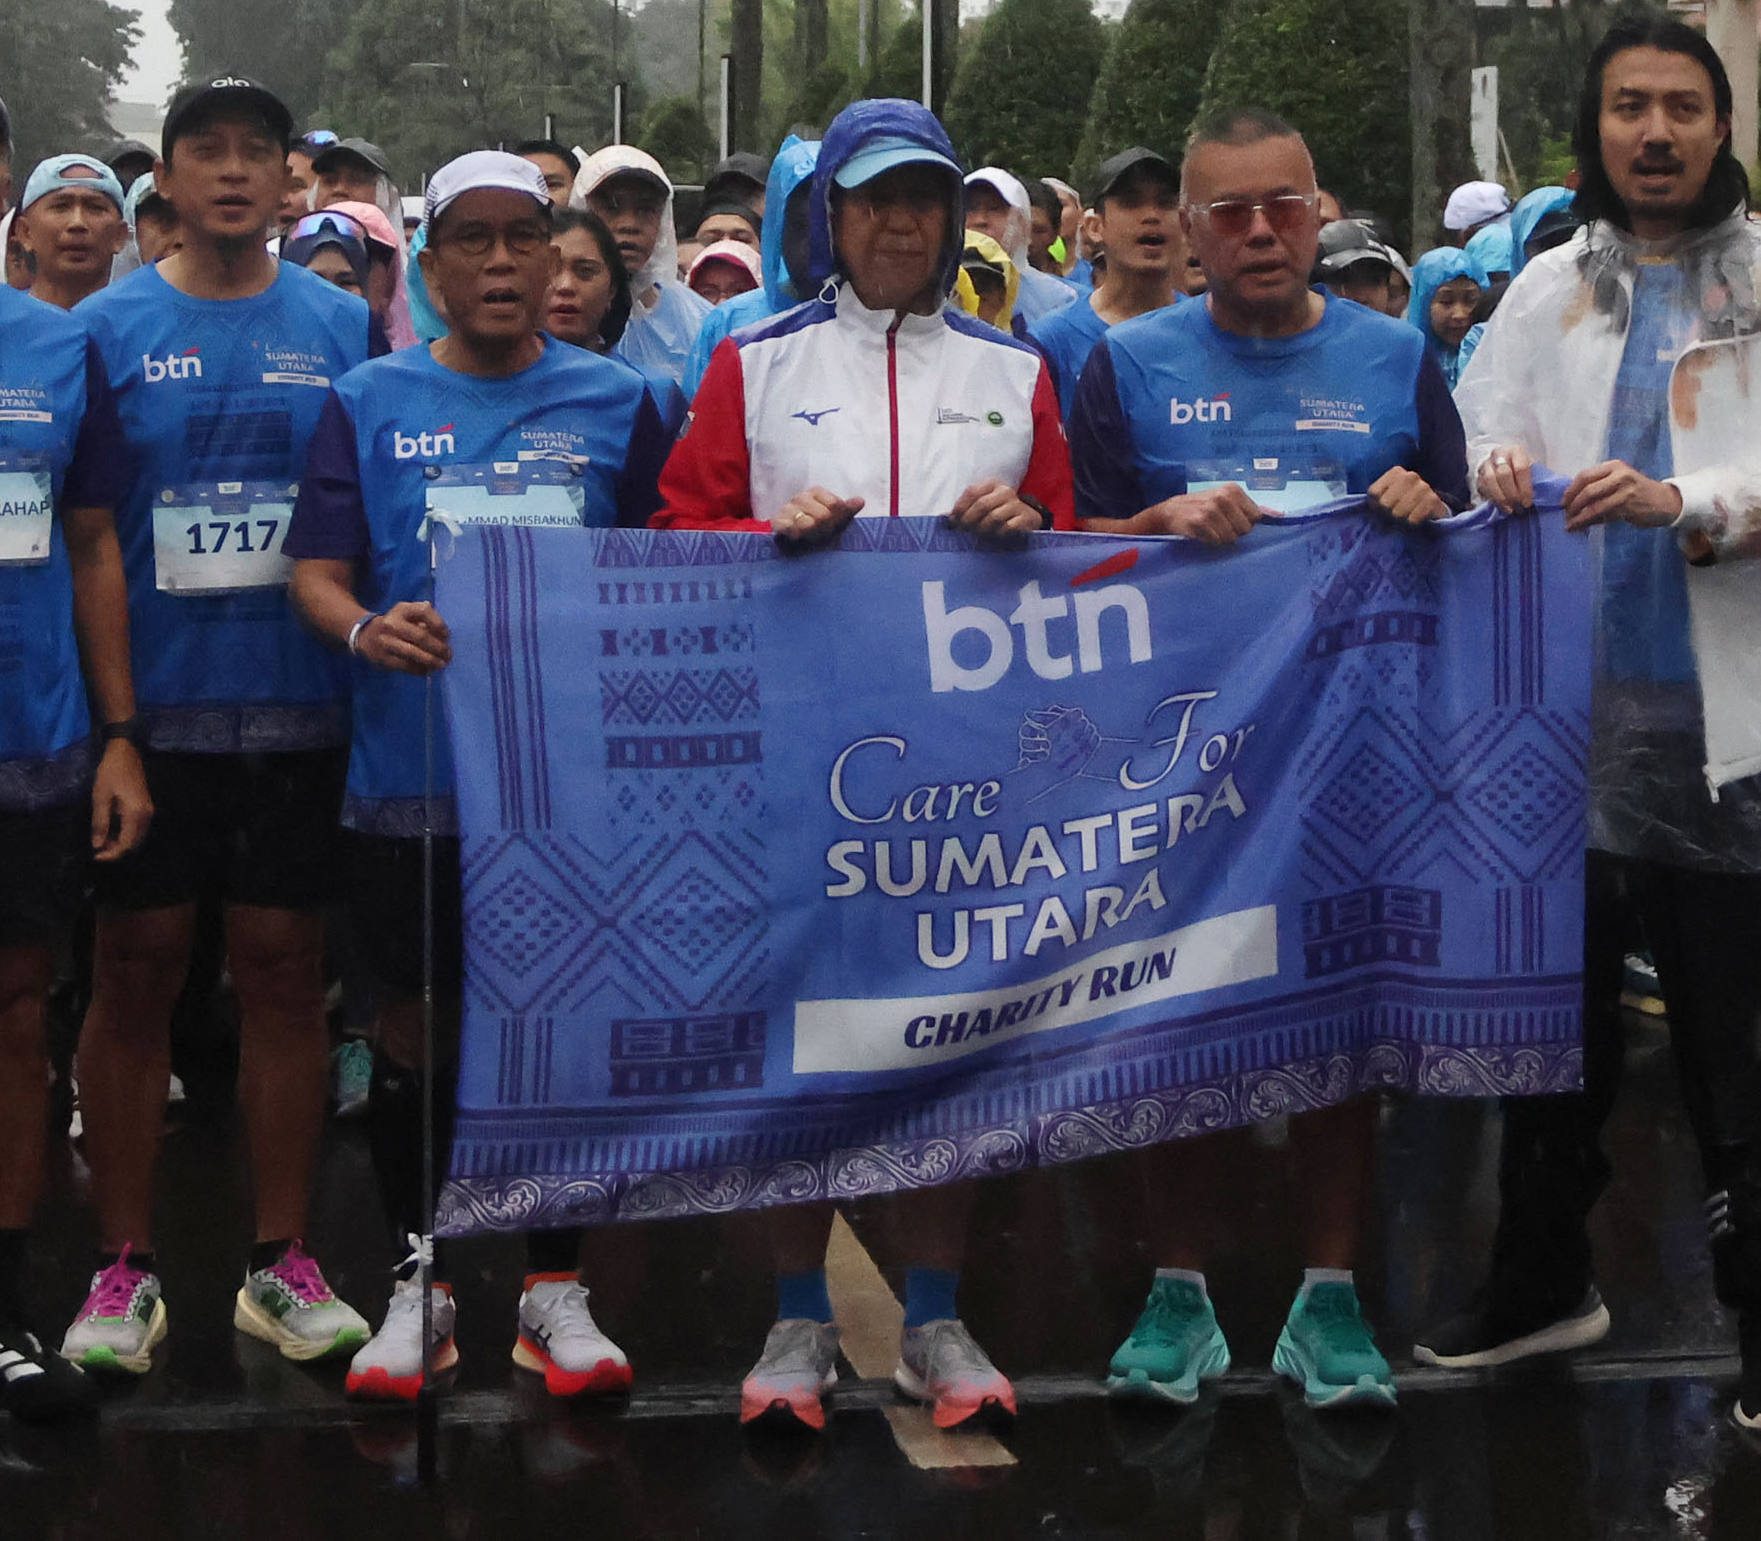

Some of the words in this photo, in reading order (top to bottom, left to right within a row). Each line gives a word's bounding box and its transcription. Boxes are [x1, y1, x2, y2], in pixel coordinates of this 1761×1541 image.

[143, 348, 202, 383] btn
[1170, 392, 1231, 424] btn
[1300, 399, 1365, 411] SUMATERA
[394, 423, 455, 459] btn
[186, 520, 278, 554] 1717
[923, 548, 1153, 693] btn
[829, 735, 1001, 824] Care
[1119, 690, 1255, 790] For
[826, 772, 1246, 898] SUMATERA
[917, 868, 1167, 970] UTARA
[904, 973, 1084, 1050] CHARITY
[1088, 948, 1176, 1002] RUN
